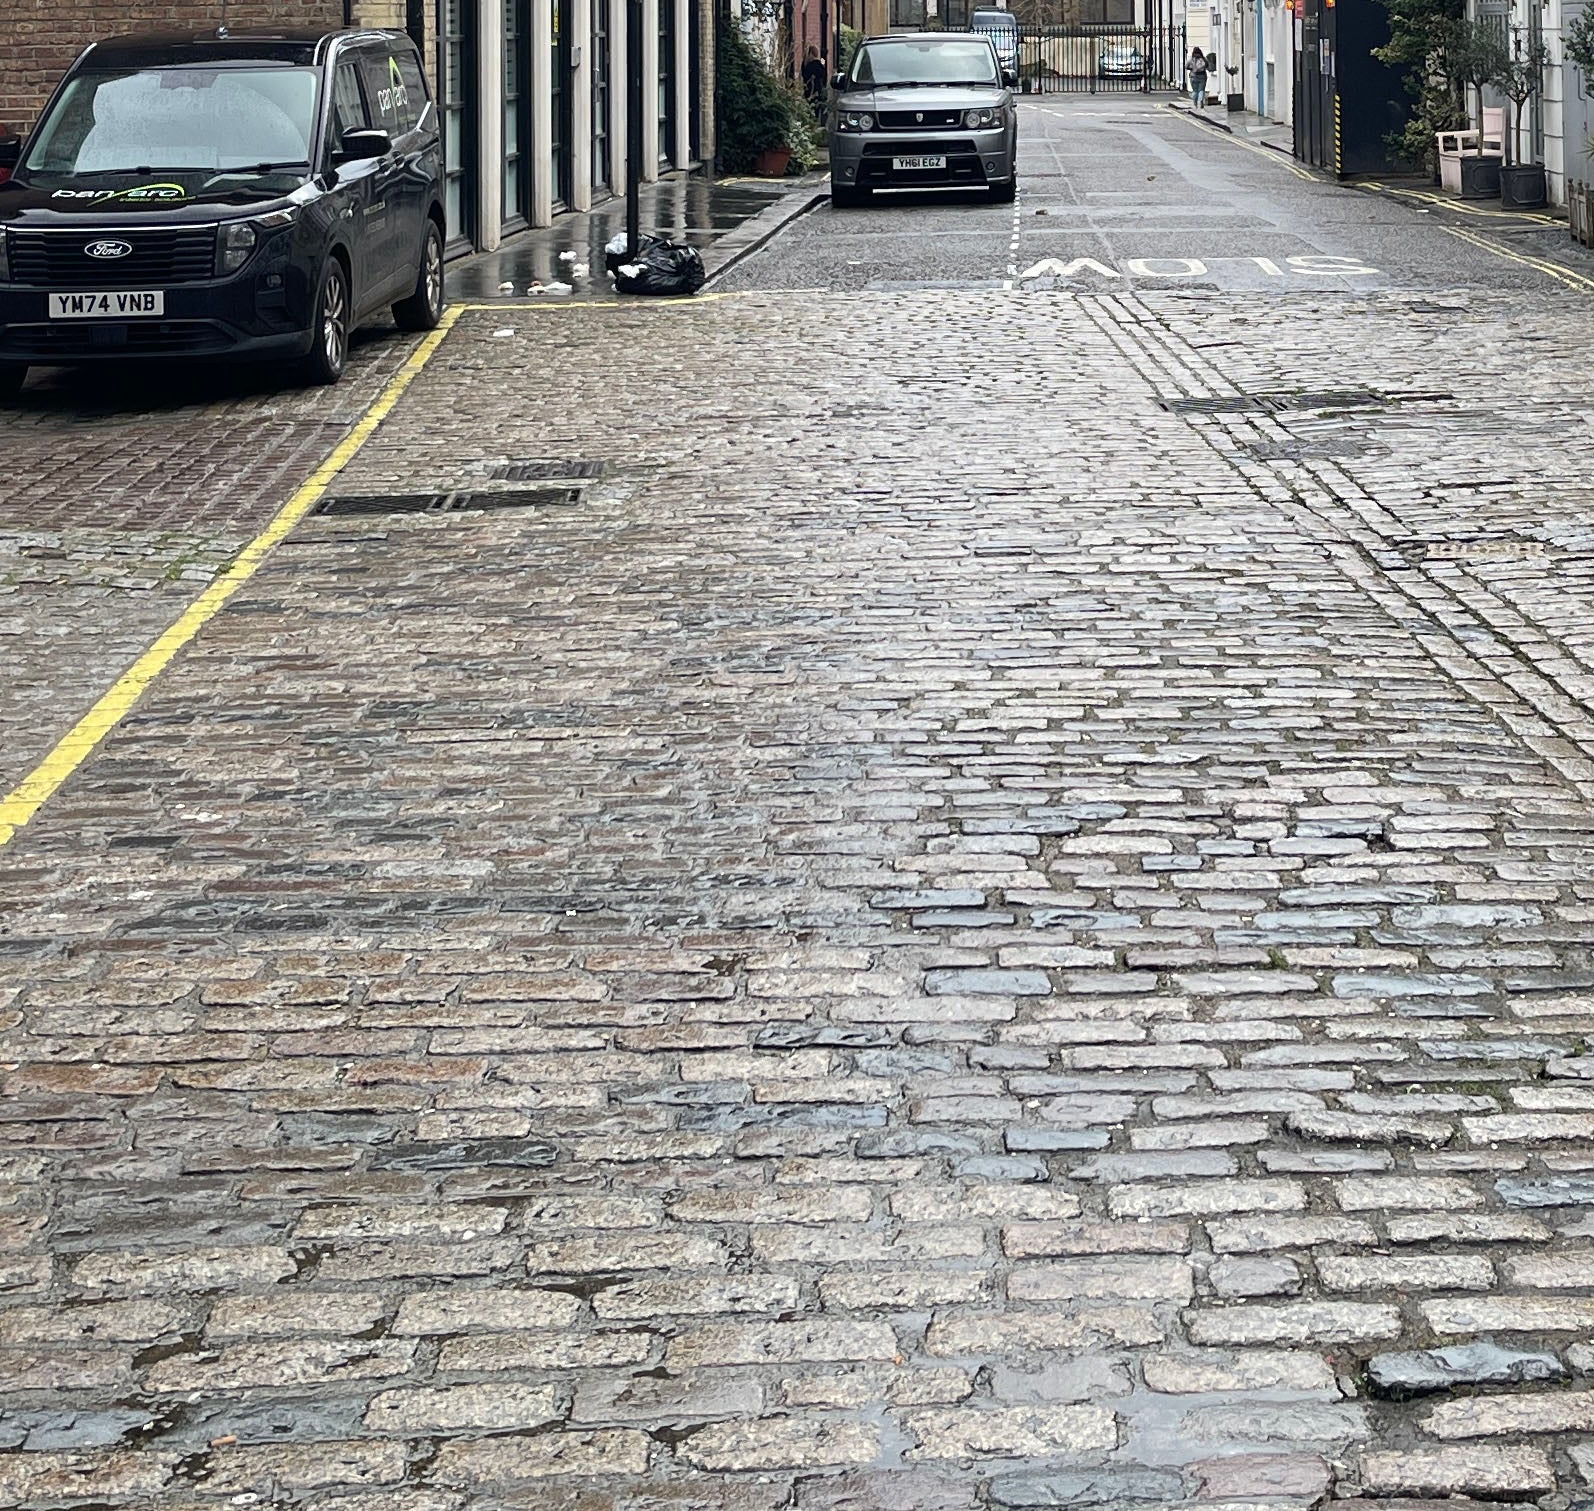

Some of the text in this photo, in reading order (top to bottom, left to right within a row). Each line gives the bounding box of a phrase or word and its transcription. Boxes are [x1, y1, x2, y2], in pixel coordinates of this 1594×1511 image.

[922, 157, 941, 167] EGZ
[93, 243, 122, 256] Ford
[1020, 256, 1380, 277] SLOW
[59, 293, 155, 313] YM74 VNB
